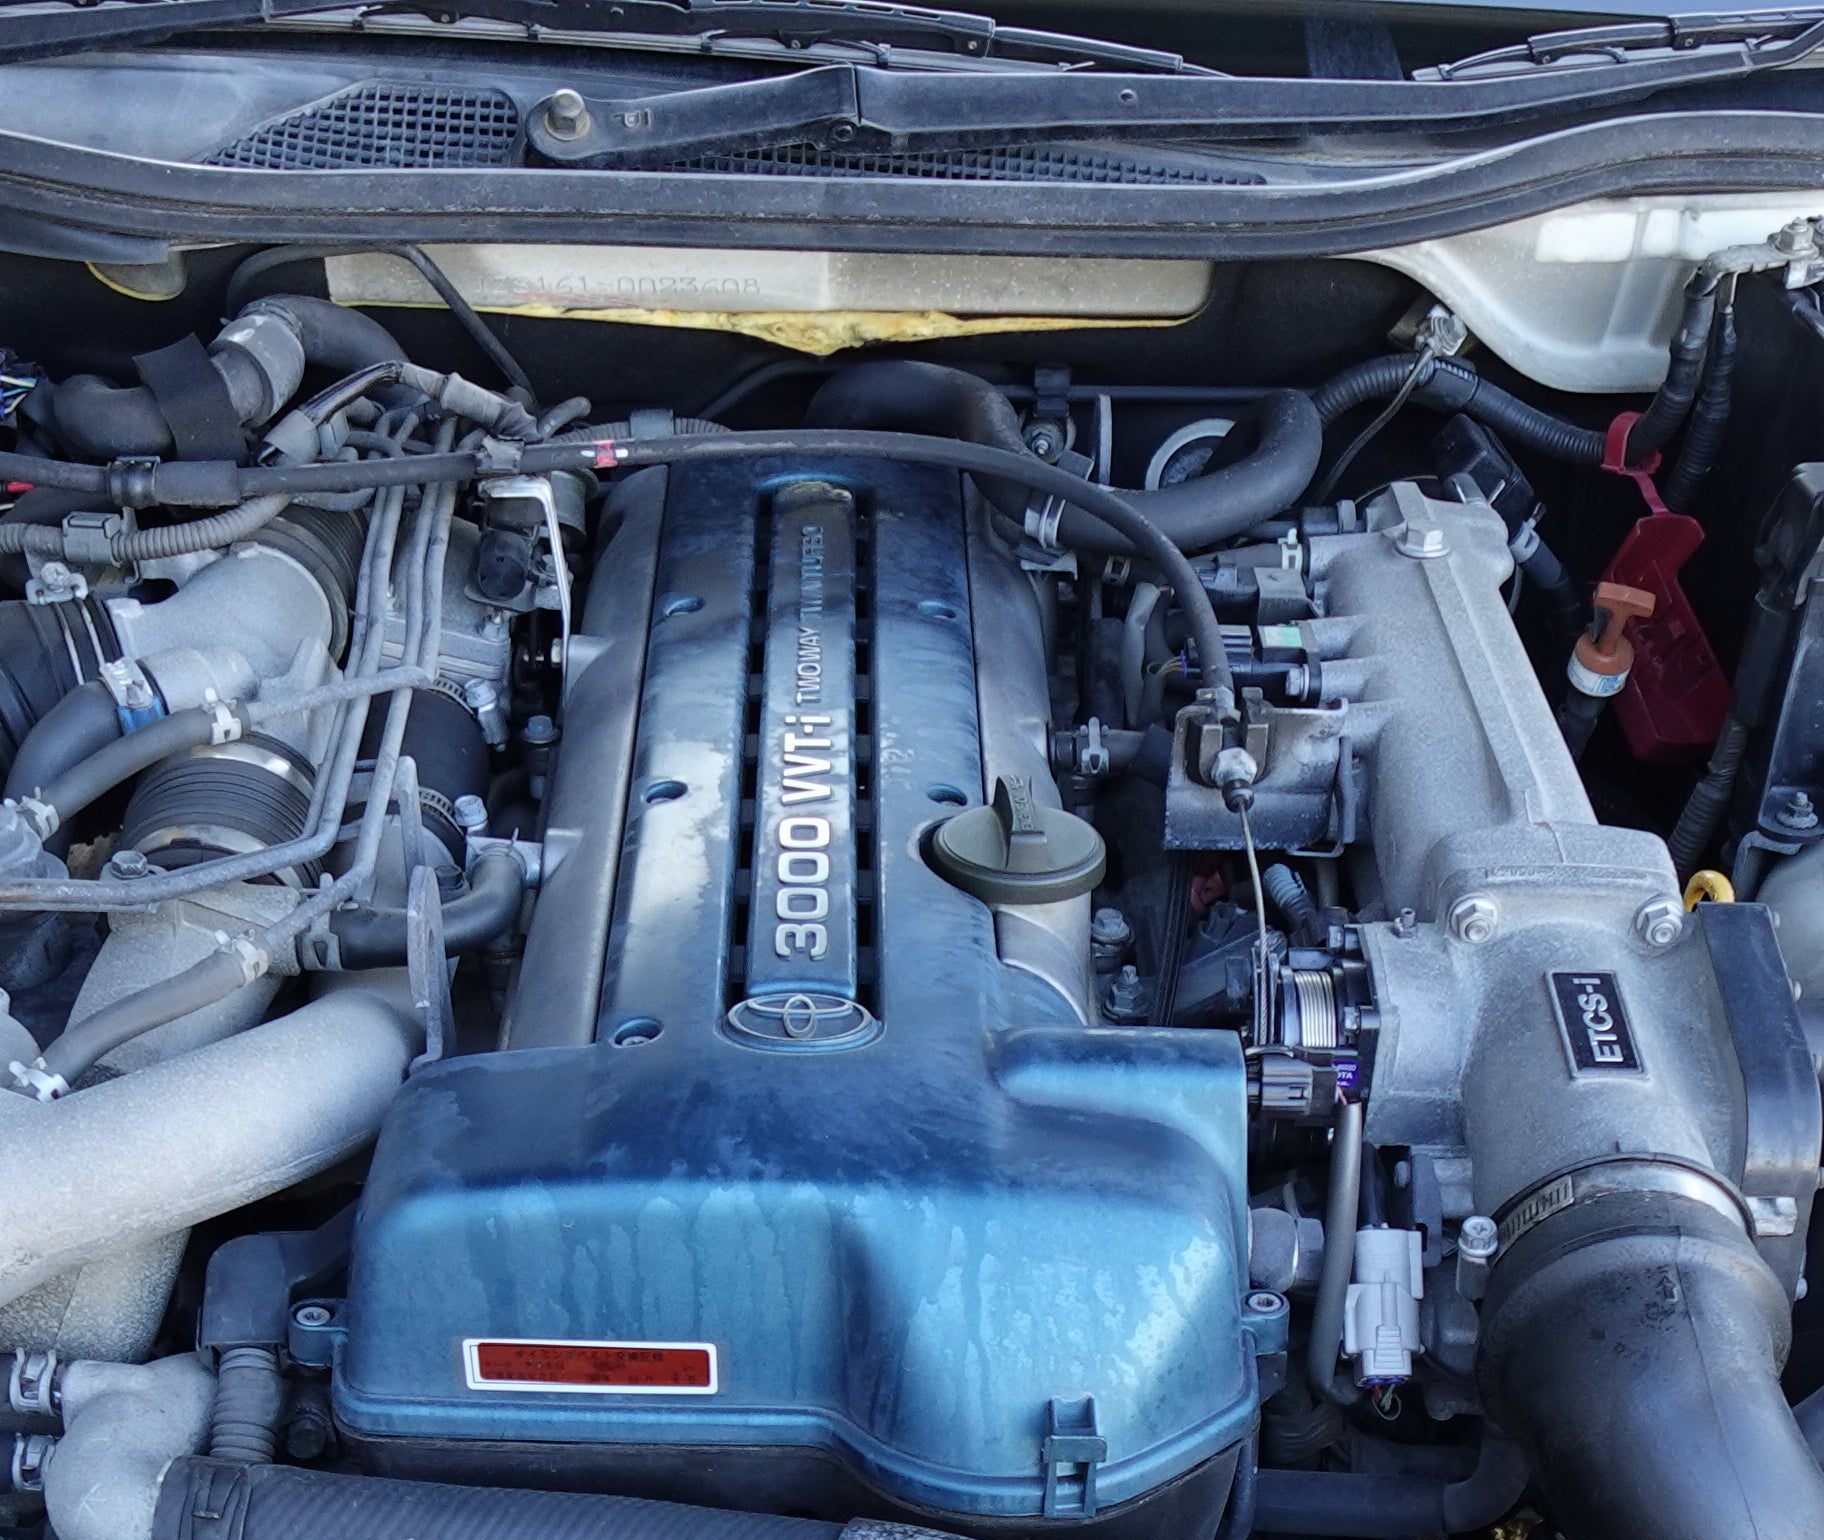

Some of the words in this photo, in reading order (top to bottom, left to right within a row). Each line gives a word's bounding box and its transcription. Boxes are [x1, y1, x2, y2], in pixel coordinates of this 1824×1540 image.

[796, 627, 822, 704] TWOWAY
[776, 817, 831, 961] 3000
[1573, 977, 1623, 1063] ETCS-i
